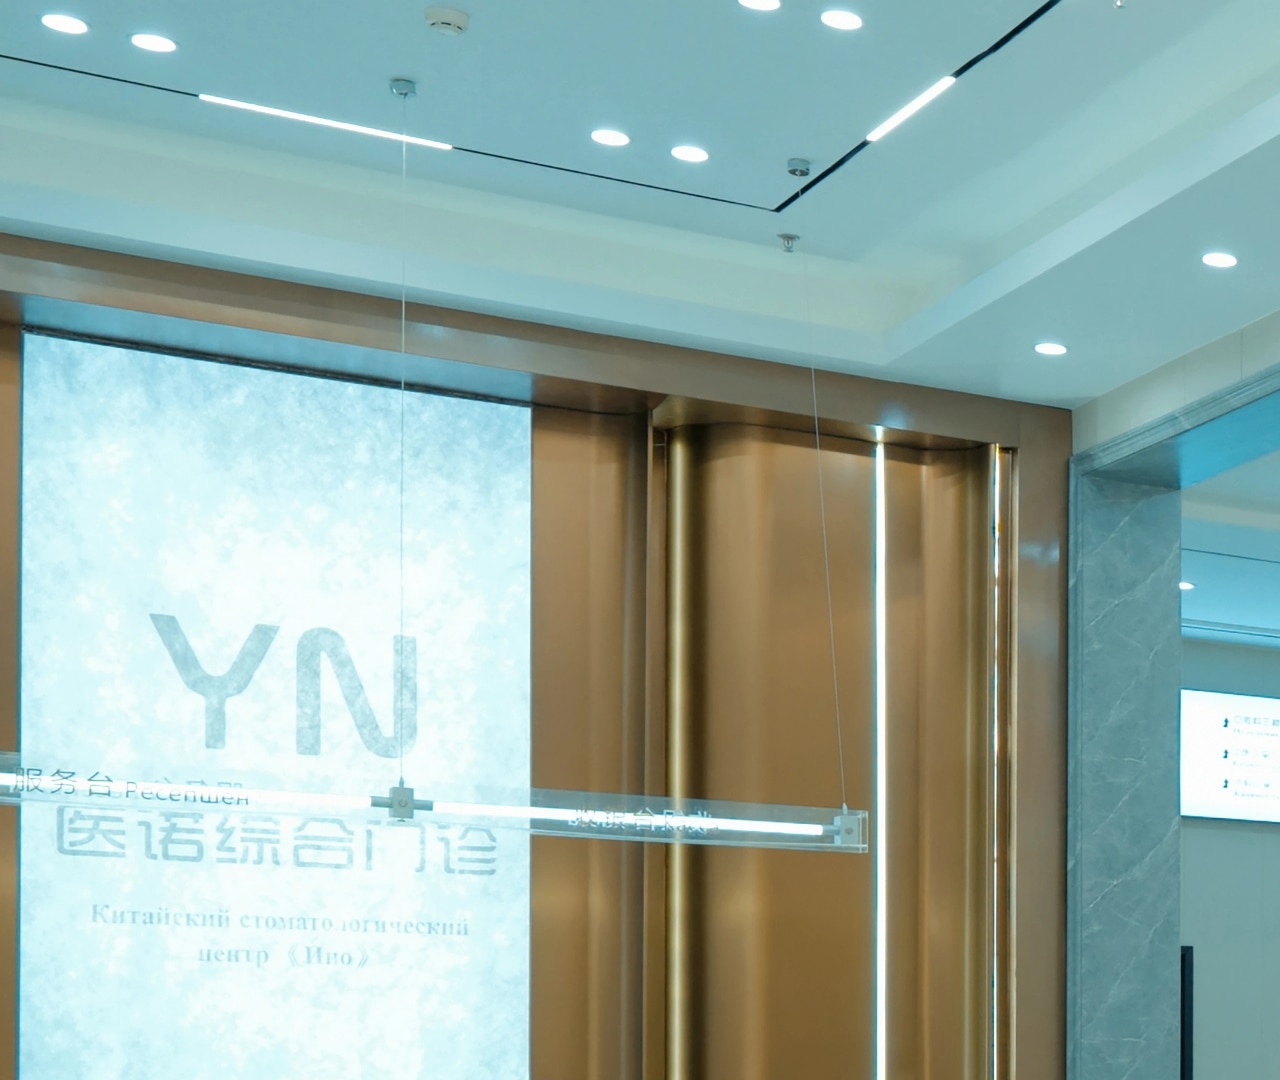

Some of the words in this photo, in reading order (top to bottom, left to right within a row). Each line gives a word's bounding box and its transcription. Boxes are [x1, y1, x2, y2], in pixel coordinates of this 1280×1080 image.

[149, 613, 417, 759] YN
[14, 767, 114, 797] 服务台
[56, 805, 498, 875] 医诺综合门诊
[91, 903, 231, 928] Китайский
[198, 946, 270, 967] центр
